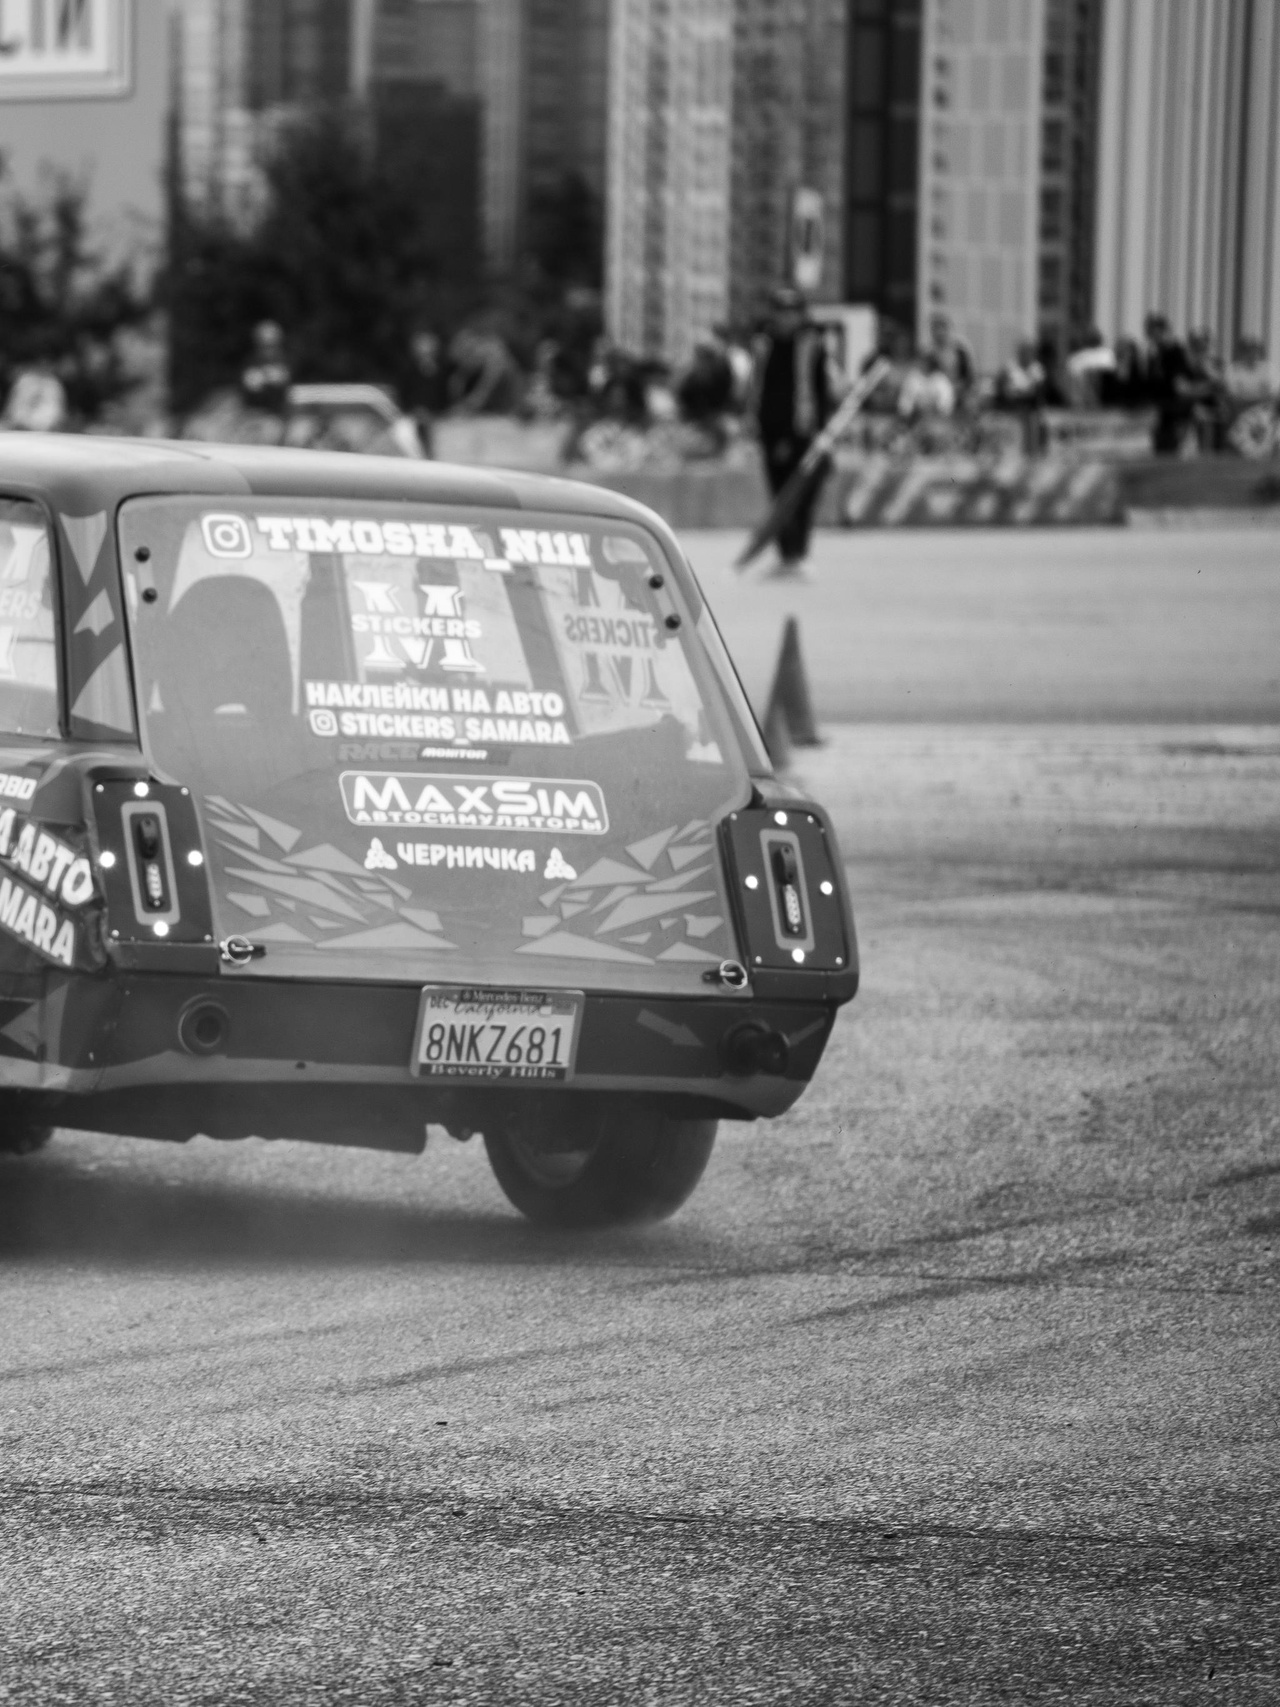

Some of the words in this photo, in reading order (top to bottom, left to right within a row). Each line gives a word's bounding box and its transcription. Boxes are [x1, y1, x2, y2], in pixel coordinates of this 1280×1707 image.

[351, 613, 483, 640] STICKERS
[305, 681, 451, 711] НАКЛЕЙКИ
[452, 688, 492, 714] НА
[495, 690, 565, 718] АВТО
[340, 711, 572, 746] STICKERS_SAMARA
[338, 742, 420, 762] RACE
[420, 747, 489, 761] MONITOR
[356, 810, 603, 832] АВТОСИМУЛЯТОРЫ
[11, 822, 94, 906] АВТО
[396, 842, 536, 873] ЧЕРНИЧКА
[426, 1023, 563, 1065] 8NKZ681
[430, 1064, 504, 1079] Beverly
[509, 1066, 557, 1079] Hills
